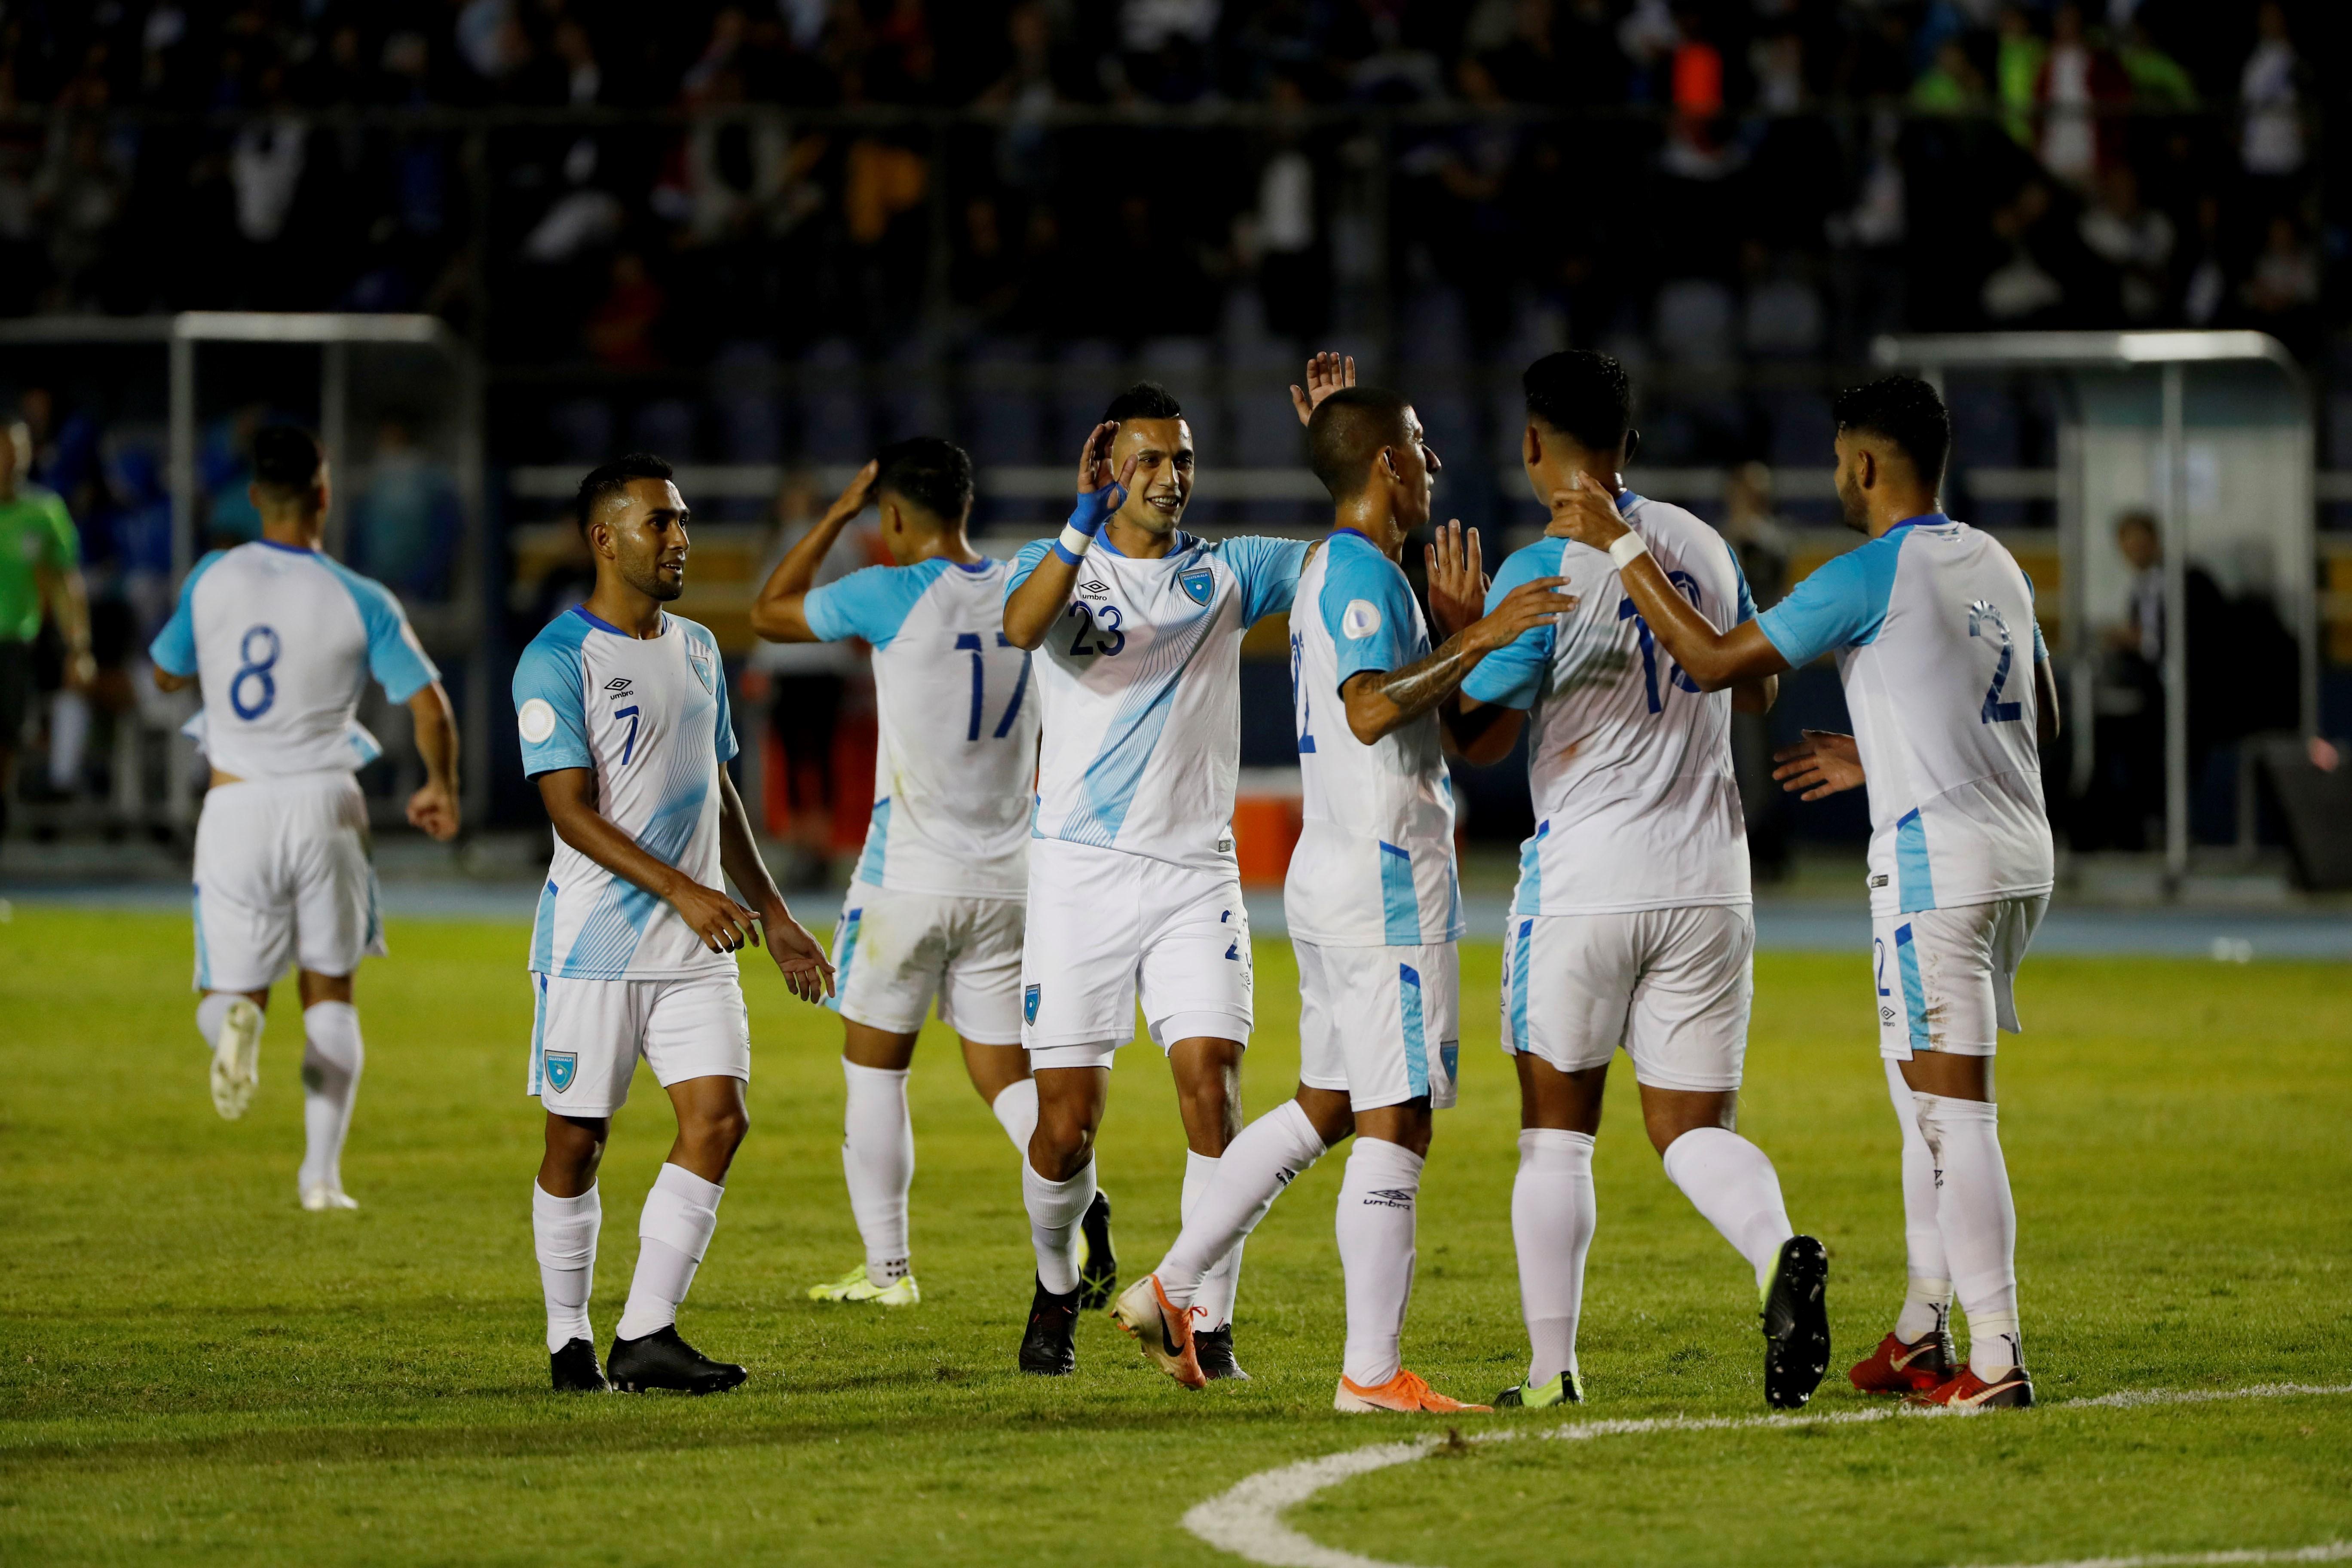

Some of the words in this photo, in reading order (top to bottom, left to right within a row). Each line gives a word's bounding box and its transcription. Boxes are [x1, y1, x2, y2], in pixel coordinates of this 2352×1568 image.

[1069, 600, 1125, 656] 23
[230, 624, 279, 721] 8
[955, 632, 1032, 741] 17
[1969, 600, 2021, 724] 2
[610, 690, 634, 700] umbro
[615, 705, 639, 766] 7
[1874, 937, 1890, 996] 2
